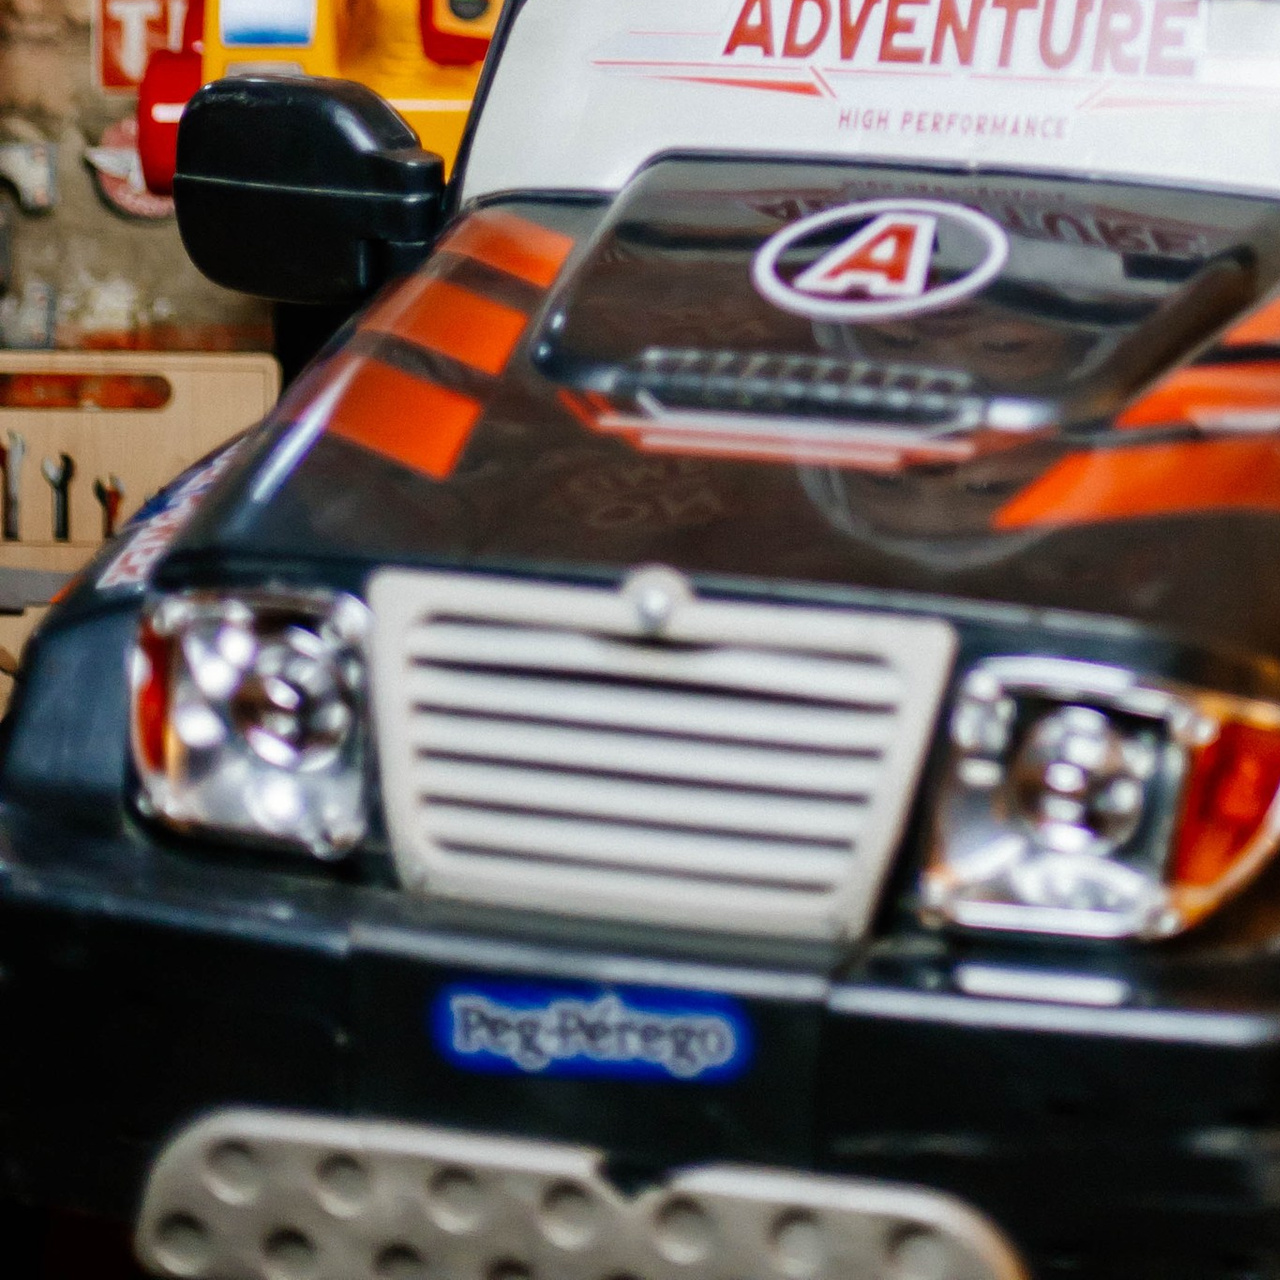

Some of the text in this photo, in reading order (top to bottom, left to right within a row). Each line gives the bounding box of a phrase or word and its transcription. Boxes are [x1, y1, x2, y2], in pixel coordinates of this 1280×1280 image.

[838, 107, 1069, 140] HIGH PERFORMANCE
[793, 211, 938, 302] A
